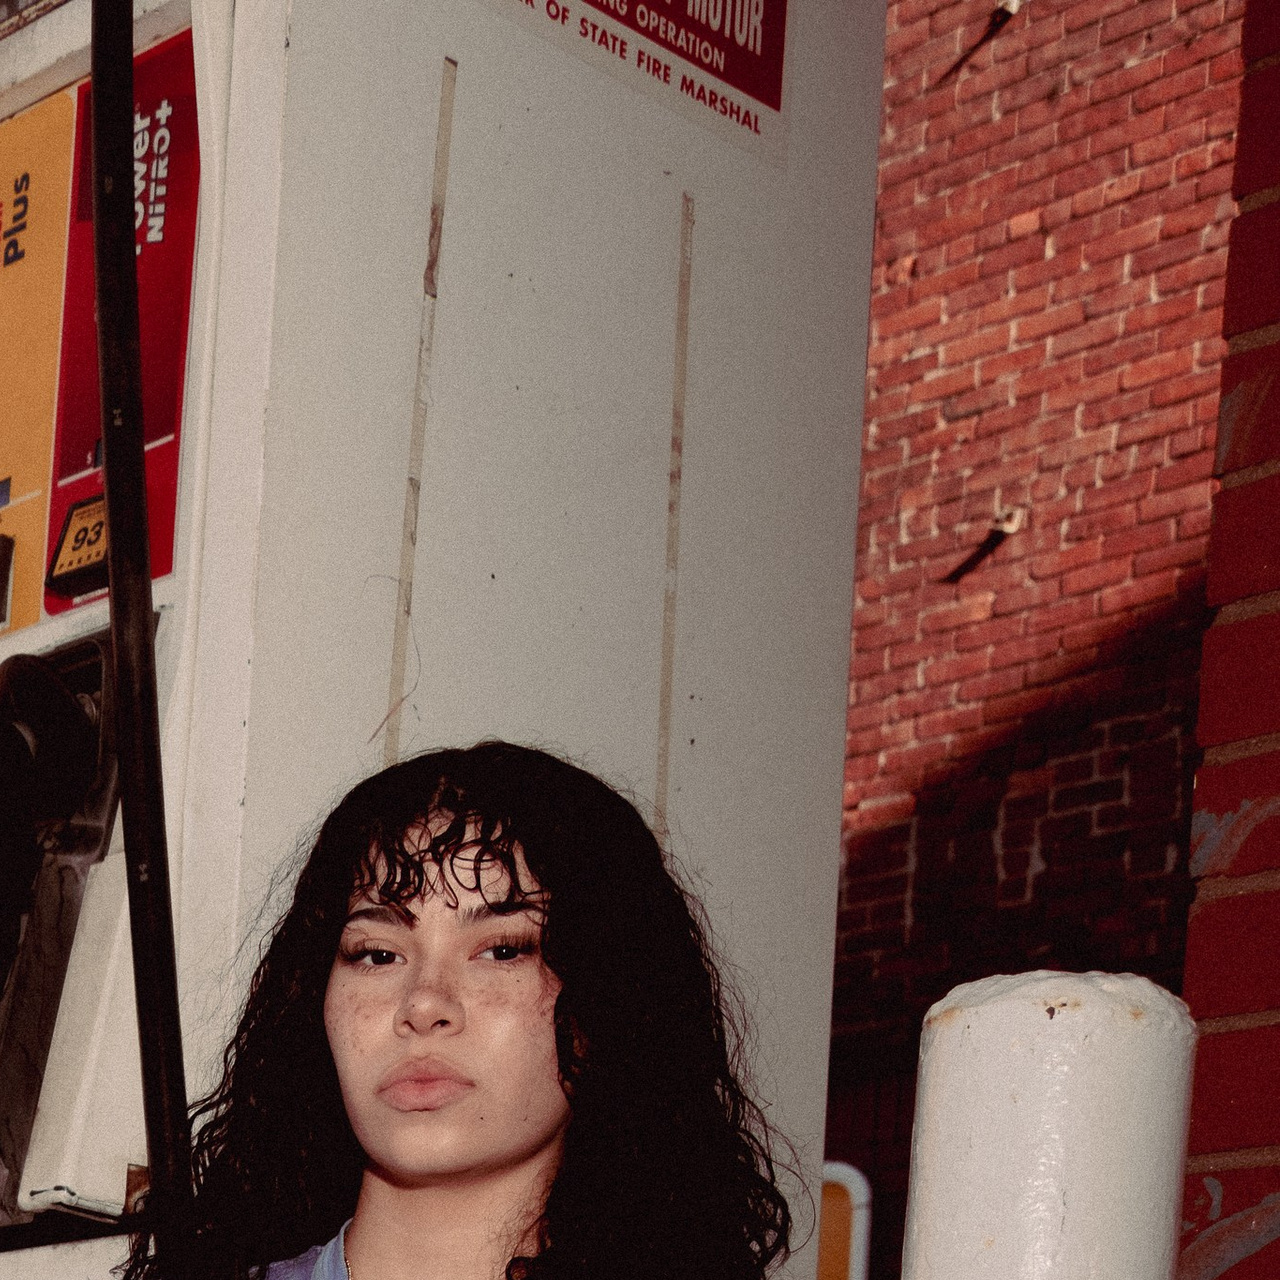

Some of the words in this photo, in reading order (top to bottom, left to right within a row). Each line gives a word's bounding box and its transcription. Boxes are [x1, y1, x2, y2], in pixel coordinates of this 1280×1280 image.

[546, 0, 570, 26] OF
[579, 17, 628, 61] STATE
[637, 49, 671, 85] FIRE
[680, 74, 761, 135] MARSHAL
[636, 4, 725, 73] OPERATION
[3, 172, 30, 268] Plus
[72, 520, 105, 552] 93
